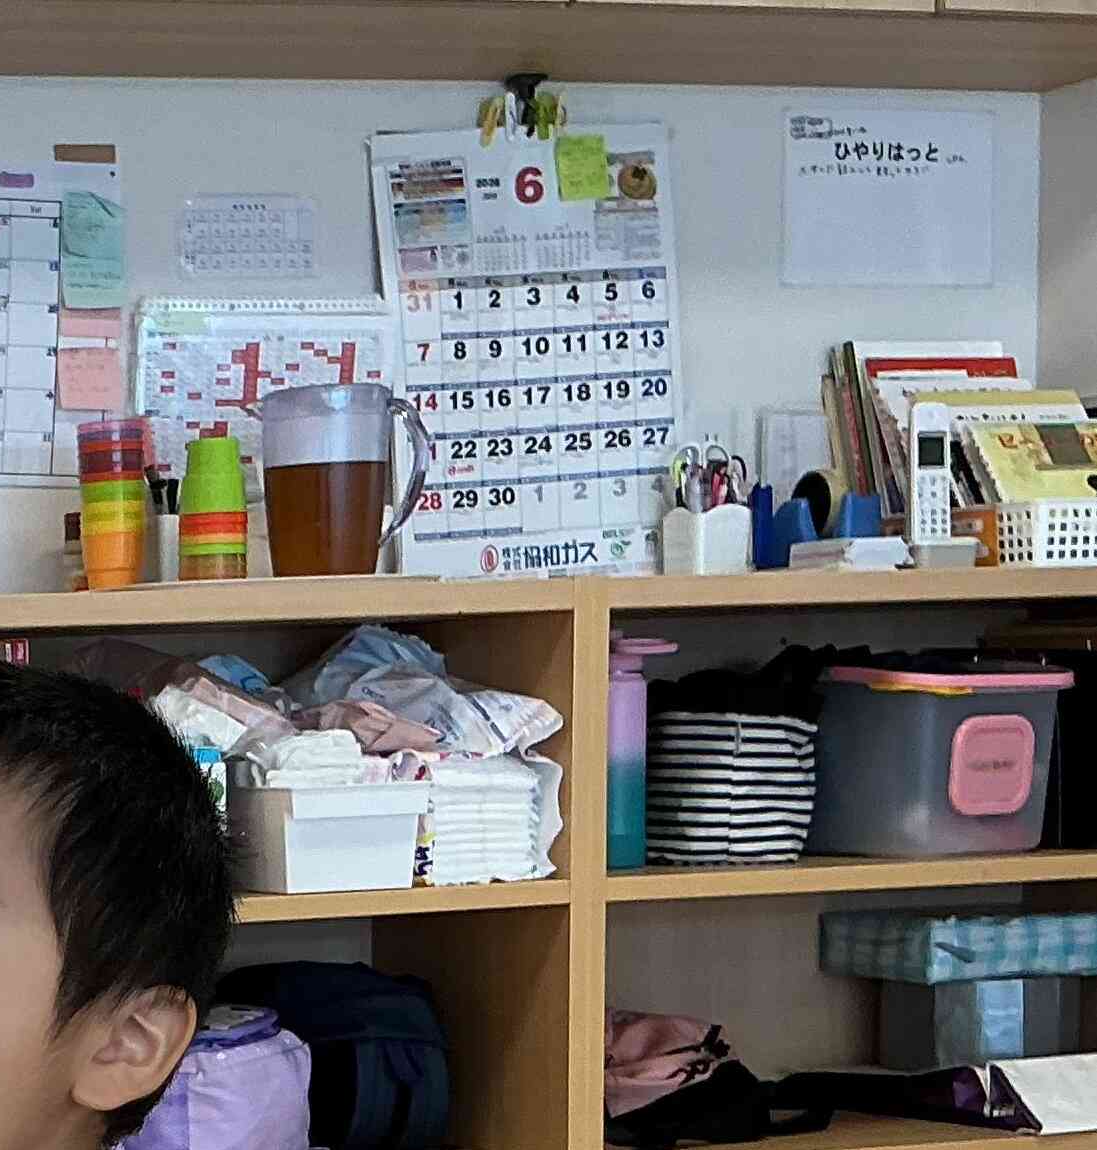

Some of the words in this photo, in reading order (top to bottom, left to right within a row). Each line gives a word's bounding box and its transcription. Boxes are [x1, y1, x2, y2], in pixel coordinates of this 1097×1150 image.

[835, 141, 938, 162] ひやりはっと
[515, 166, 544, 204] 6
[407, 294, 432, 312] 31
[454, 291, 462, 309] 1
[489, 290, 500, 308] 2
[527, 287, 540, 305] 3
[567, 285, 579, 303] 4
[605, 283, 617, 301] 5
[642, 281, 655, 299] 6
[417, 343, 429, 361] 7
[454, 341, 466, 359] 8
[489, 340, 501, 358] 9
[522, 337, 549, 355] 10
[563, 334, 586, 352] 11
[602, 331, 628, 350] 12
[640, 330, 664, 348] 13
[414, 393, 437, 412] 14
[450, 391, 473, 409] 15
[486, 389, 511, 408] 16
[523, 386, 550, 405] 17
[564, 383, 591, 401] 18
[604, 380, 629, 399] 19
[642, 378, 667, 397] 20
[452, 440, 477, 459] 22
[488, 438, 513, 457] 23
[525, 436, 552, 454] 24
[565, 432, 592, 451] 25
[605, 429, 631, 448] 26
[643, 427, 668, 445] 27
[419, 492, 441, 511] 28
[453, 490, 478, 508] 29
[489, 487, 515, 505] 30
[535, 485, 543, 502] 1
[574, 482, 587, 499] 2
[613, 478, 626, 496] 3
